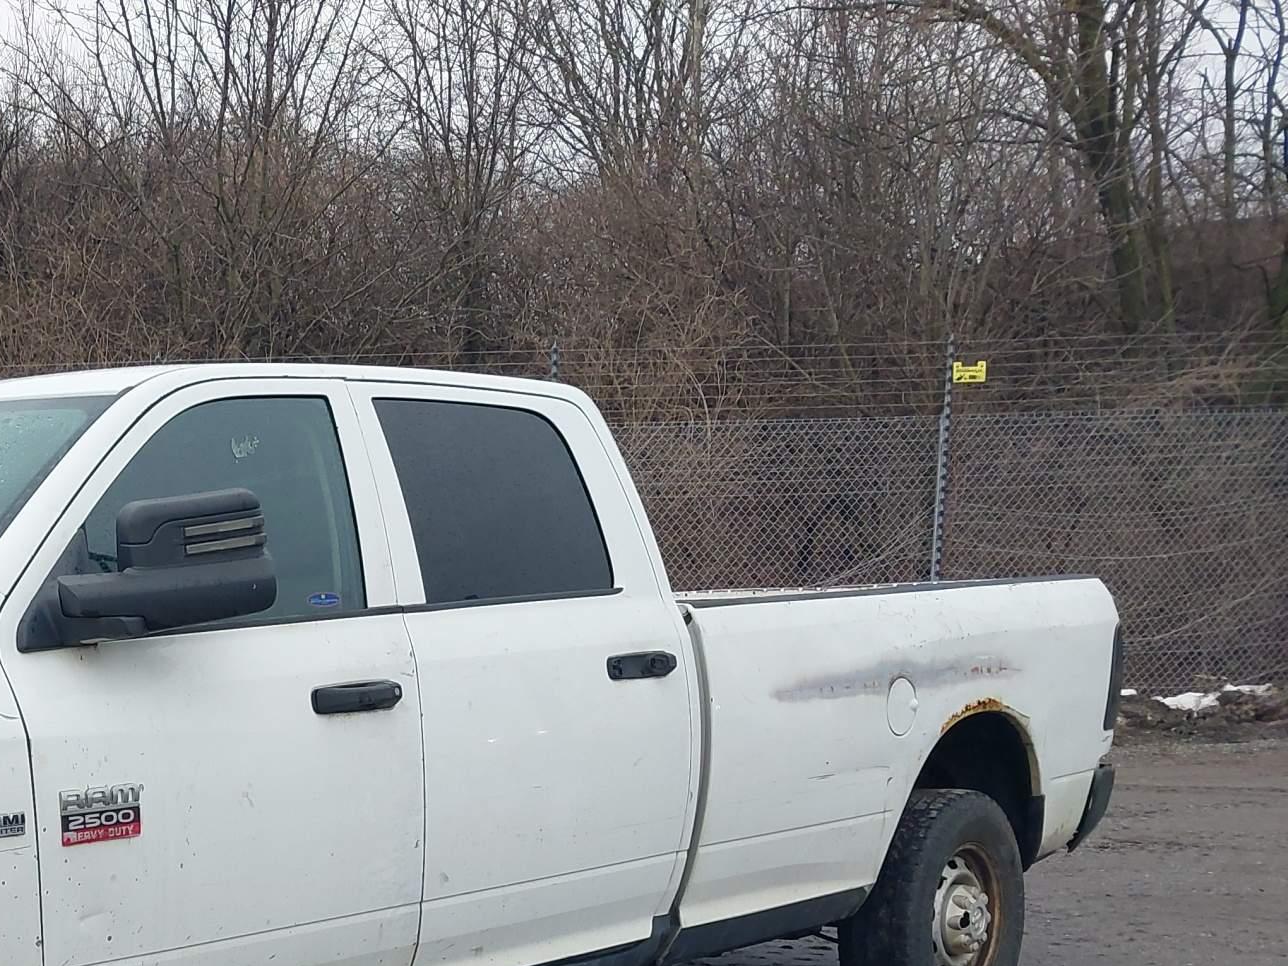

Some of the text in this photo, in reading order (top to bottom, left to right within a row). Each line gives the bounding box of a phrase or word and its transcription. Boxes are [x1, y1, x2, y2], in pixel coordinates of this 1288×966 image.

[59, 785, 144, 811] RAM
[68, 810, 135, 830] 2500
[108, 825, 135, 838] DUTY
